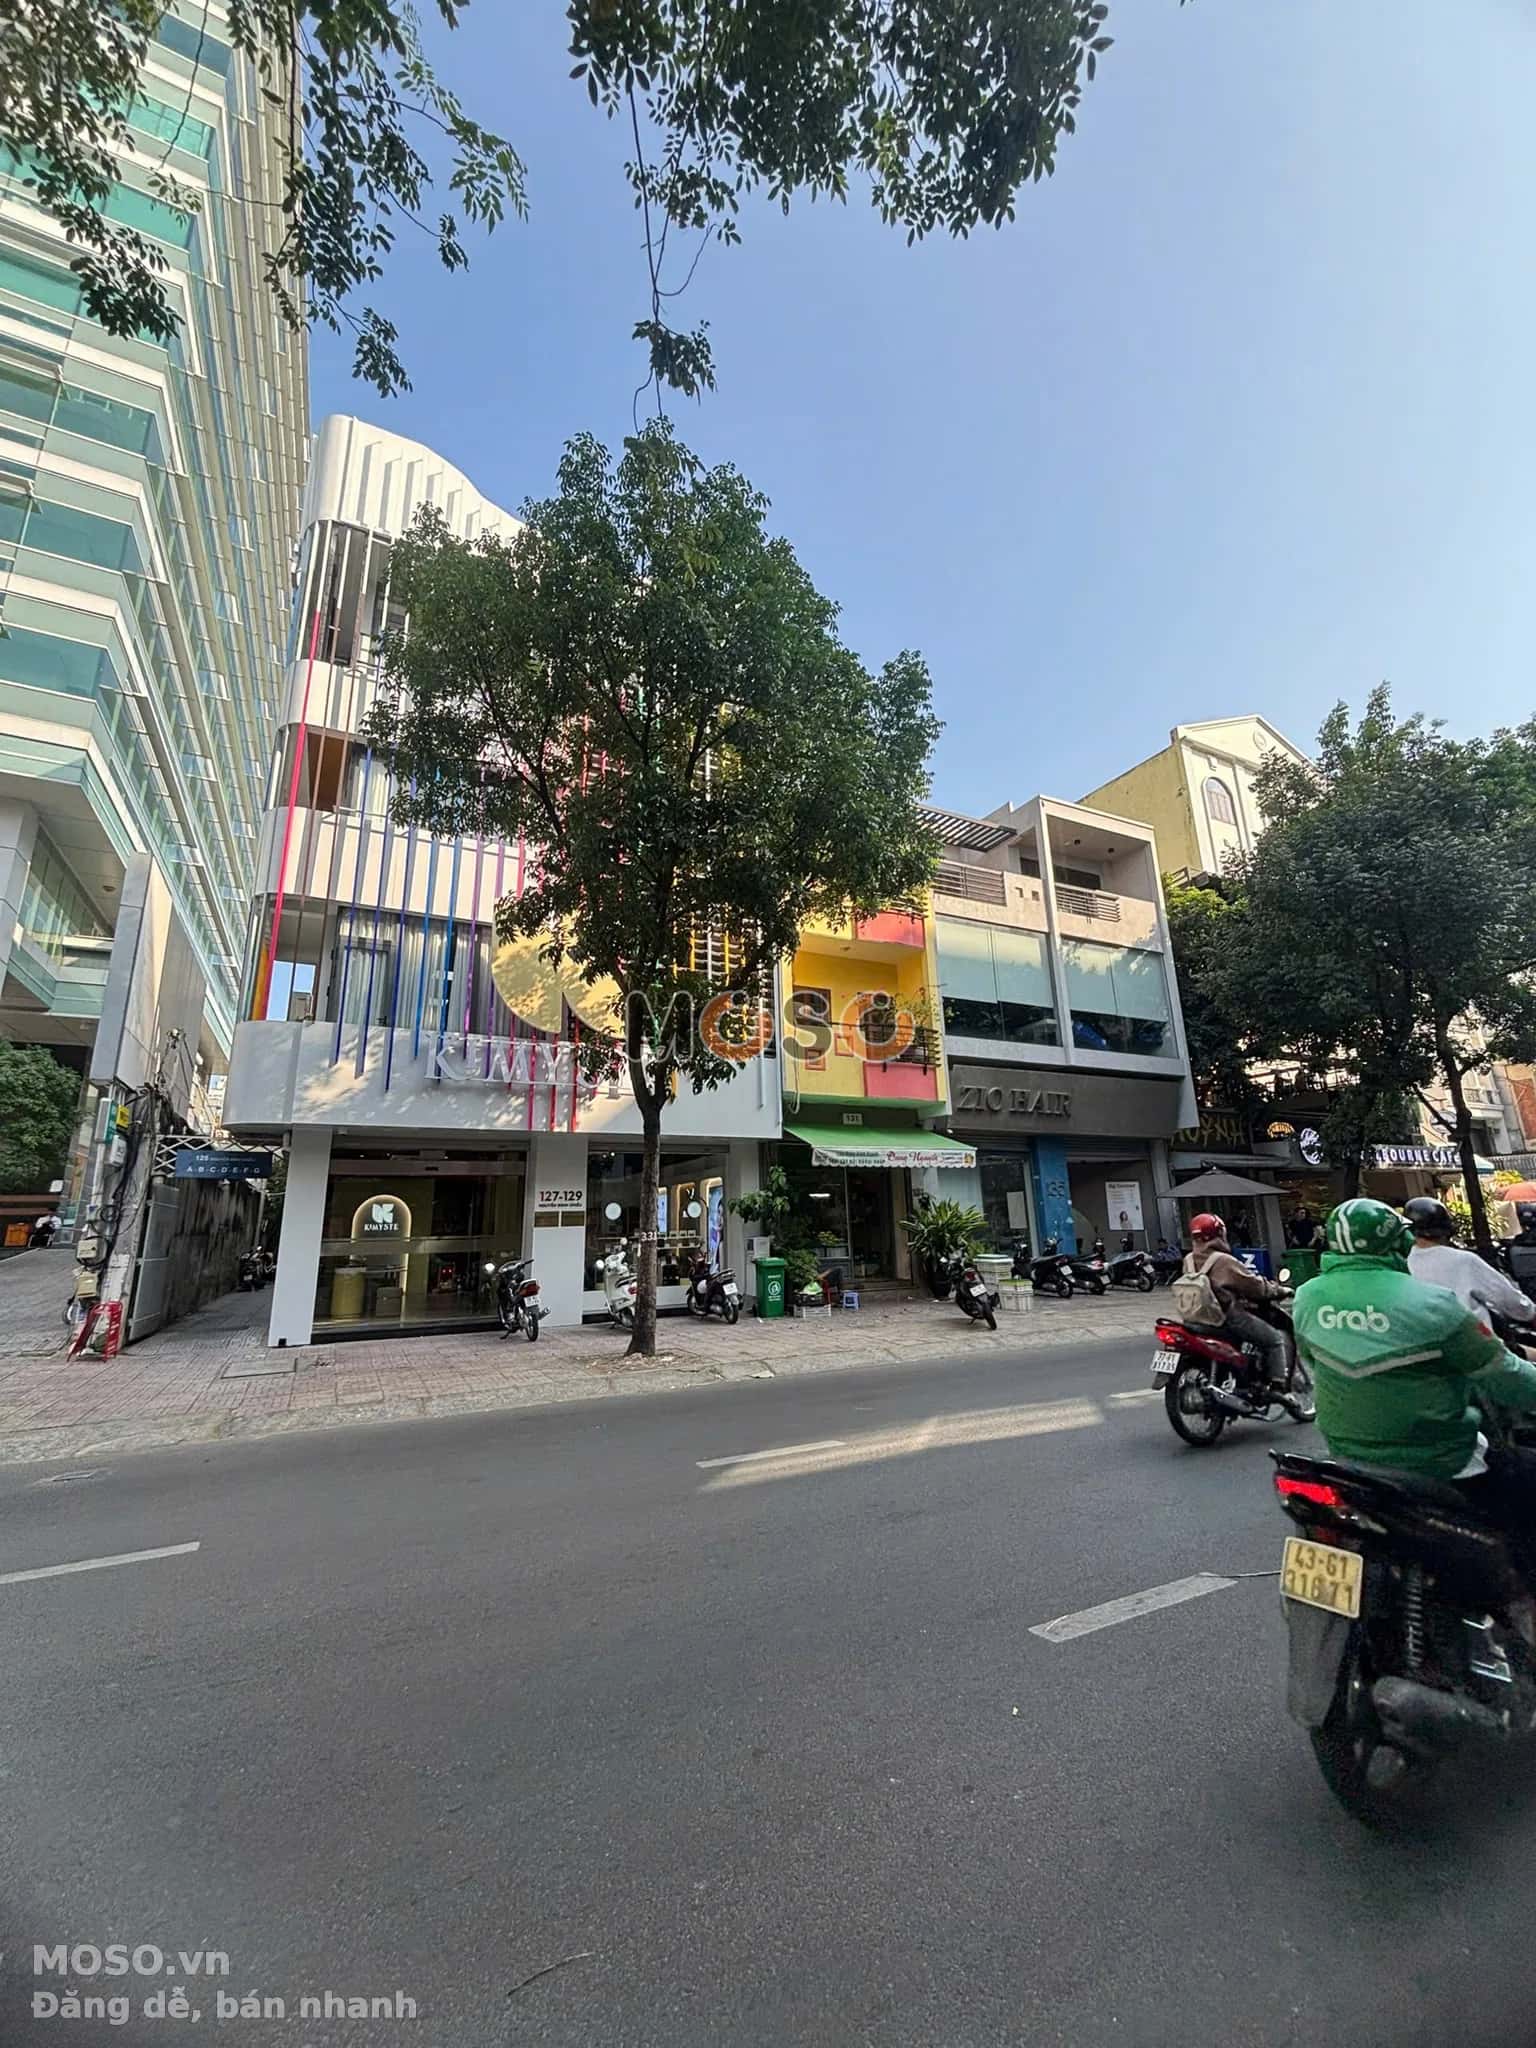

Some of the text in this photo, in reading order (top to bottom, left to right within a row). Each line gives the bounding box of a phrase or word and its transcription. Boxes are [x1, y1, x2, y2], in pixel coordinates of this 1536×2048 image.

[1009, 1088, 1072, 1118] HAIR
[540, 1190, 583, 1202] 127-129
[1317, 1304, 1390, 1333] Grab
